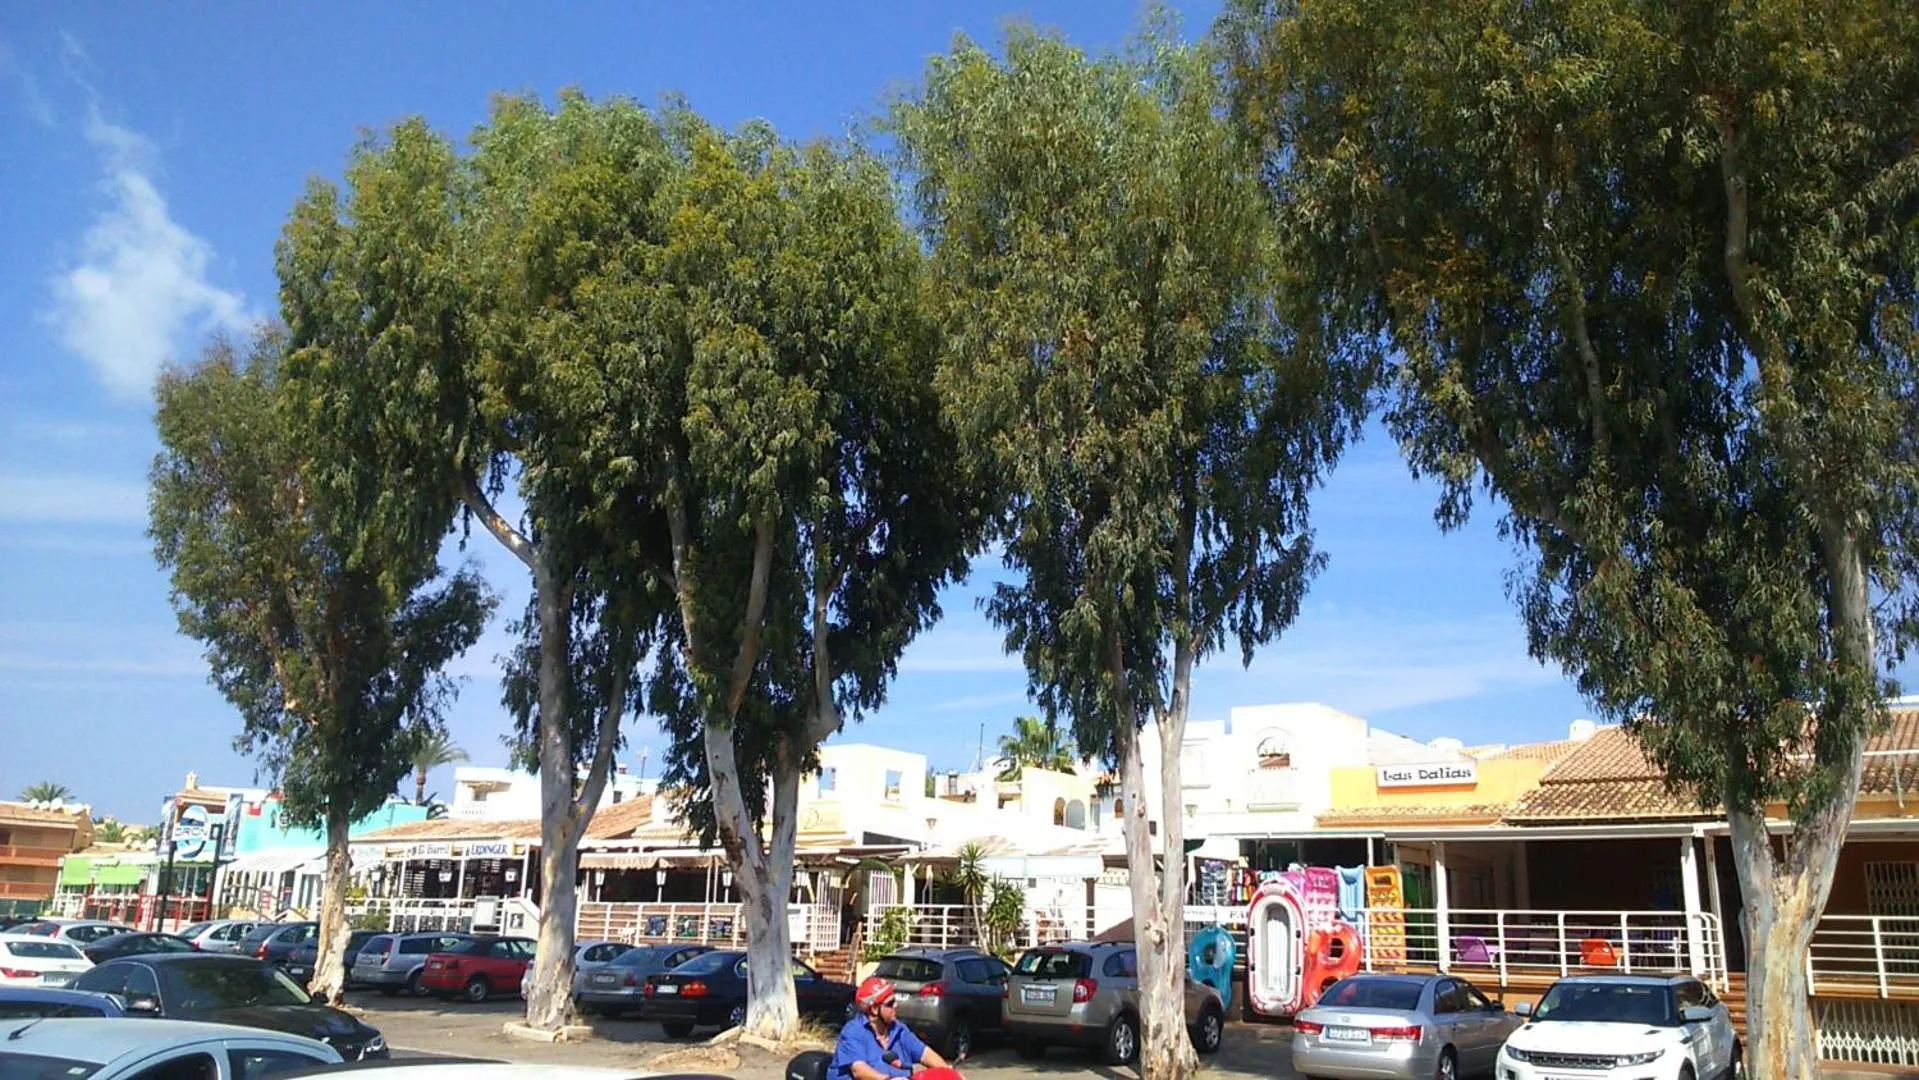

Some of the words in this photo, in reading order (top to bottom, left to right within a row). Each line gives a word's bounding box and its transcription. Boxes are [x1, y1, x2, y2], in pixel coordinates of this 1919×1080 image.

[1383, 770, 1412, 781] Las
[1418, 767, 1472, 779] Dalias
[471, 844, 508, 855] ERDINGER
